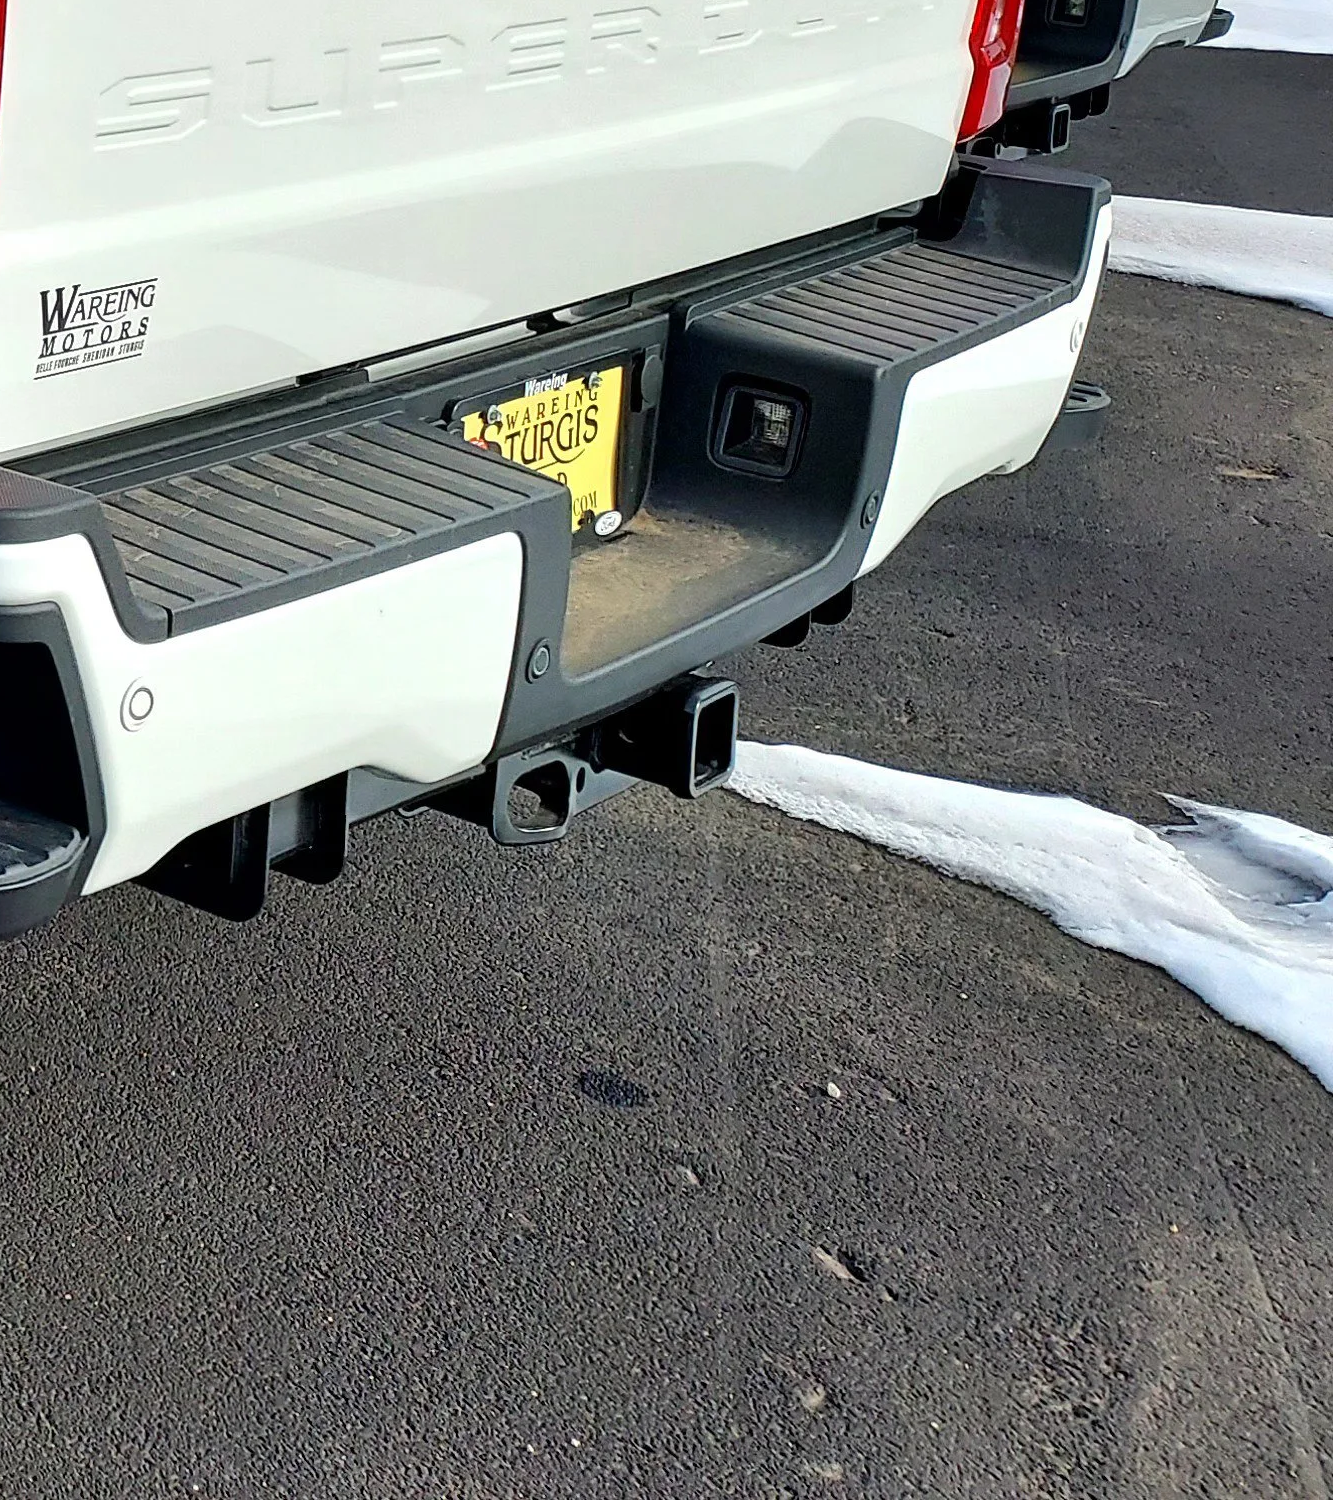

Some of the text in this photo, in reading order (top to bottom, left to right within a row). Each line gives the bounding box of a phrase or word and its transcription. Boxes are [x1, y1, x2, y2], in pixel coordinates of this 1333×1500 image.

[93, 5, 661, 152] SUPER
[38, 316, 149, 359] MOTORS
[525, 373, 568, 397] Wareing
[506, 387, 598, 430] WAREING
